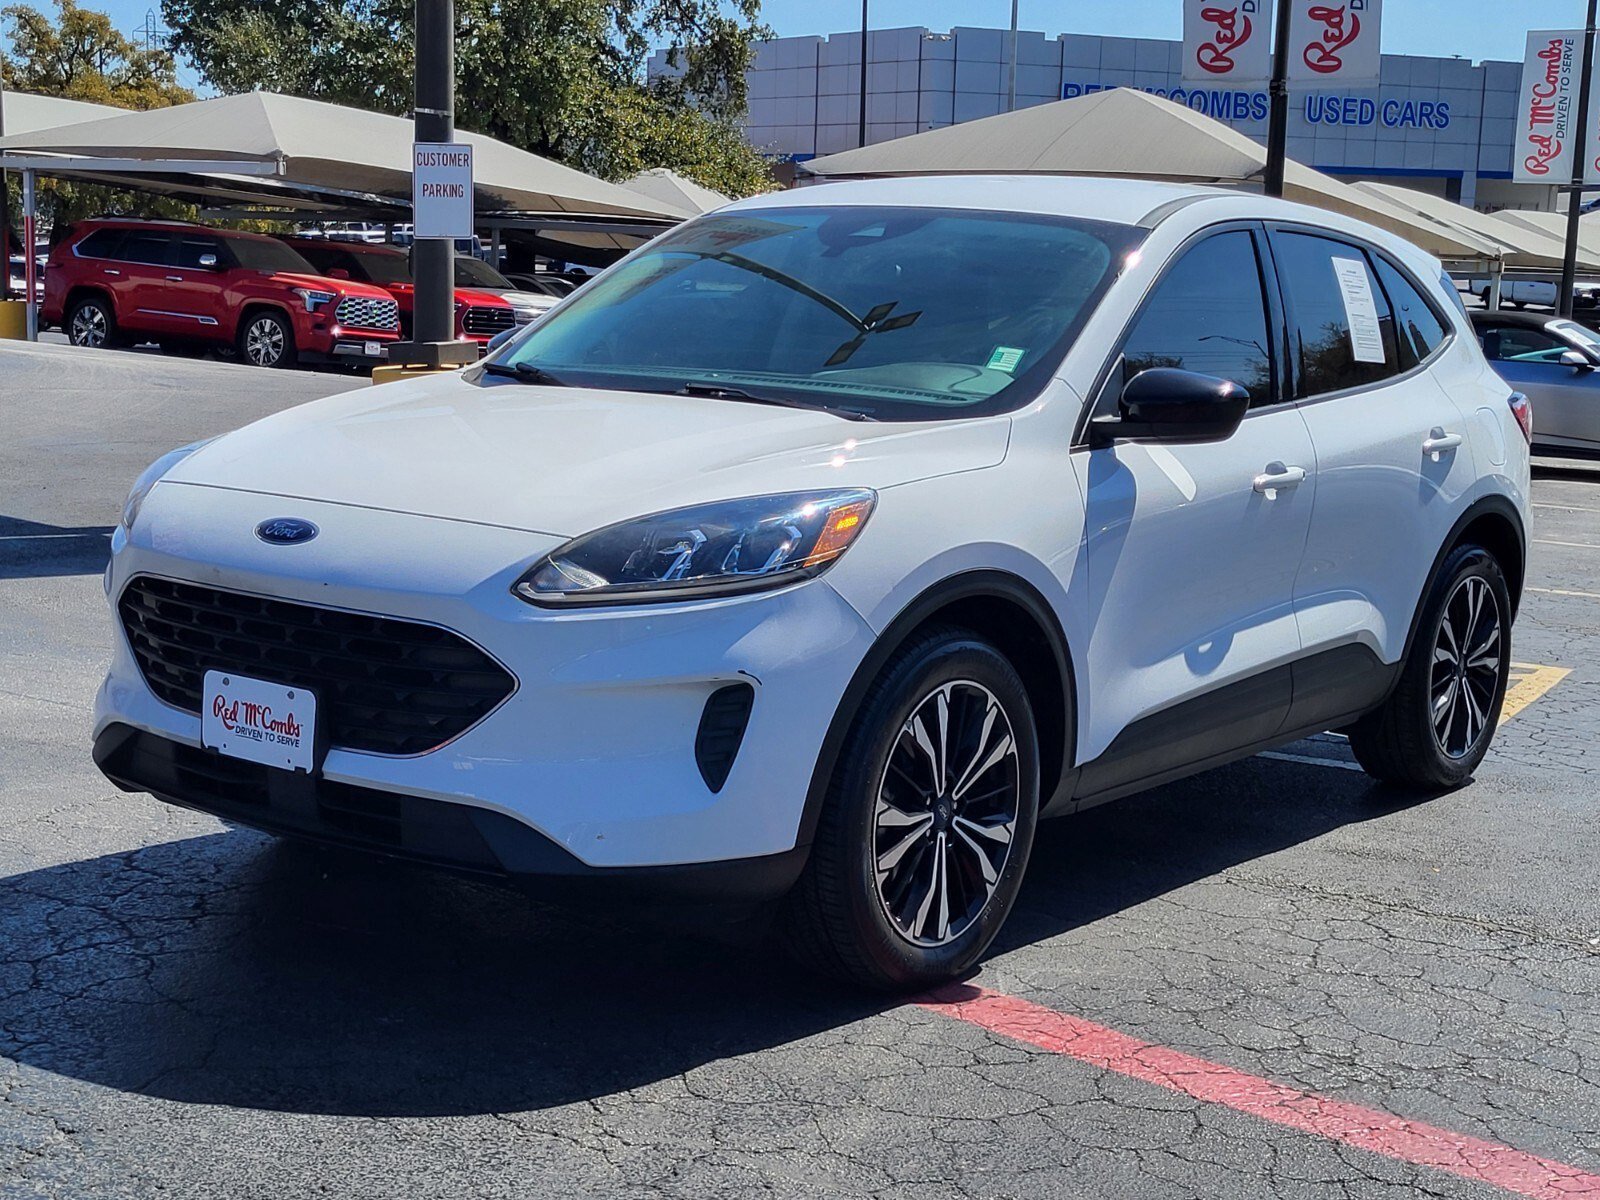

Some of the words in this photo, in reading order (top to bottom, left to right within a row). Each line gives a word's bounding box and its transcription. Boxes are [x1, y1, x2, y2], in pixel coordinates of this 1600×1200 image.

[1196, 6, 1253, 74] Red
[1303, 5, 1361, 74] Red
[1561, 38, 1574, 73] SERVE
[1528, 38, 1563, 131] McCombs
[1560, 76, 1570, 92] TO
[1132, 86, 1268, 121] OMBS
[1306, 95, 1376, 126] USED
[1382, 99, 1450, 129] CARS
[1556, 96, 1569, 139] DRIVEN
[416, 152, 470, 167] CUSTOMER
[1524, 134, 1562, 175] Red
[422, 183, 464, 198] PARKING
[213, 694, 239, 731] Red
[241, 701, 300, 738] McCombs
[235, 725, 263, 740] DRIVEN
[264, 732, 275, 743] TO
[276, 735, 300, 748] SERVE
